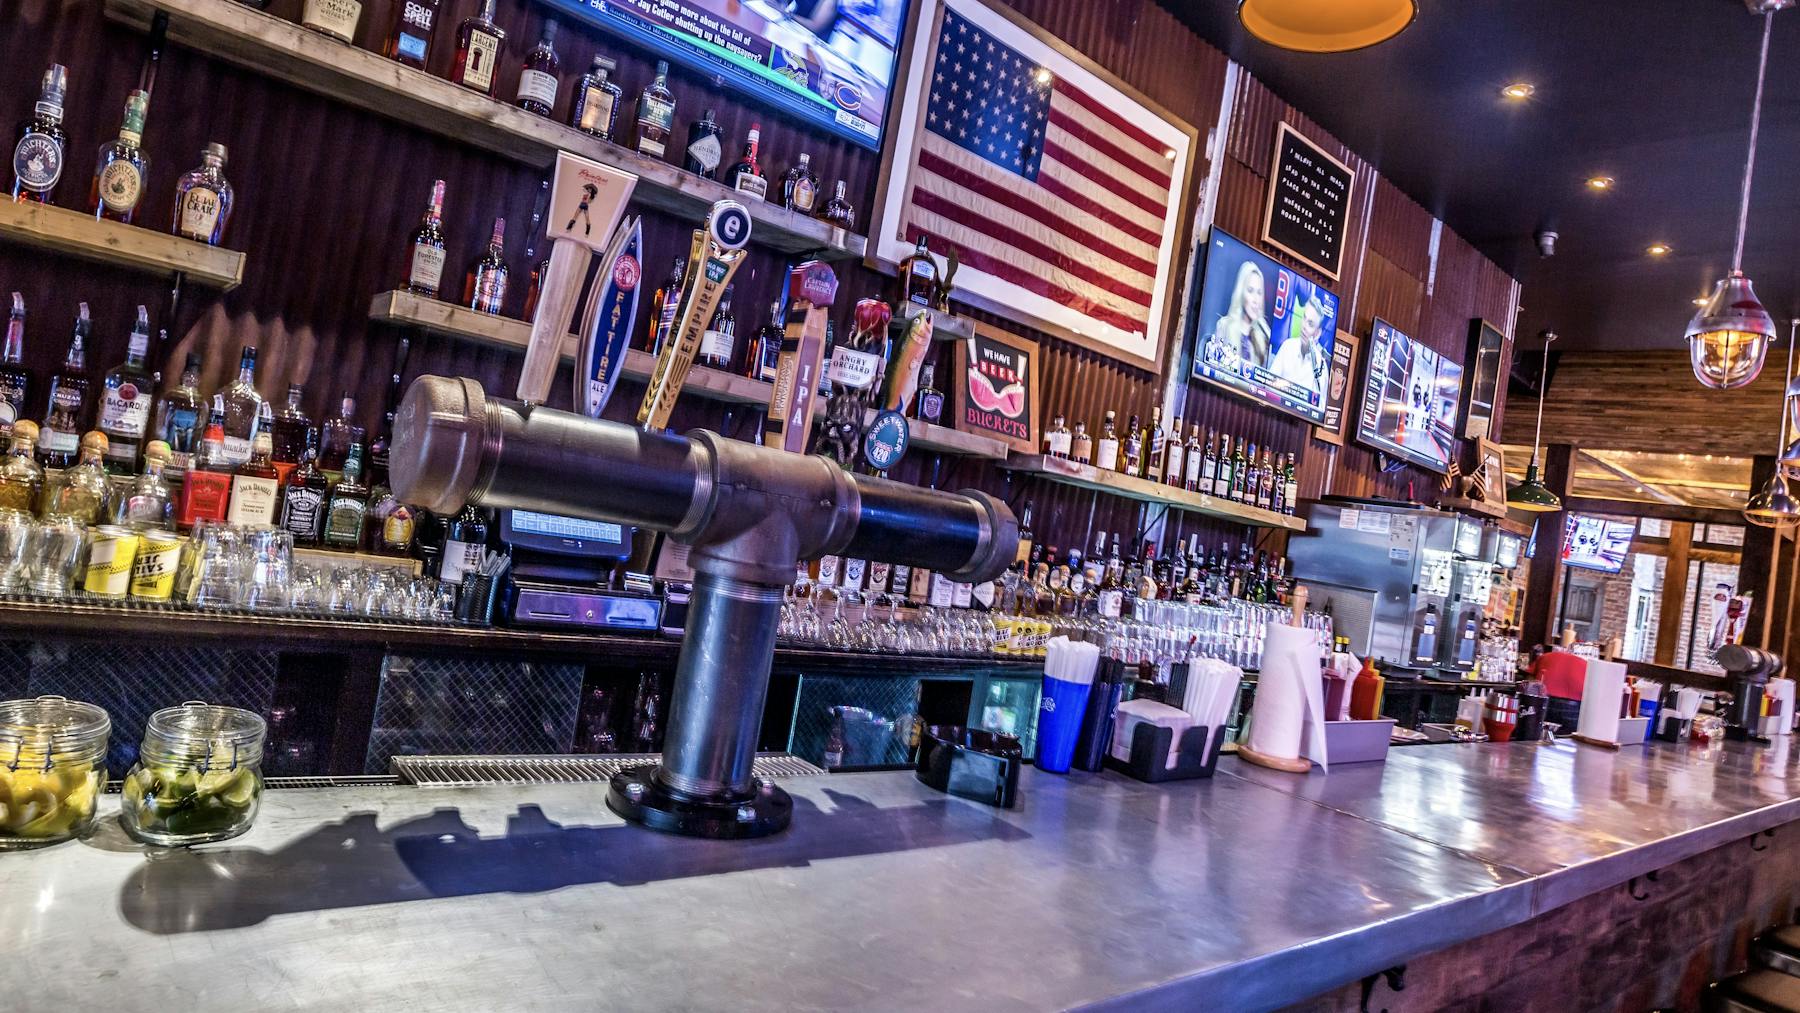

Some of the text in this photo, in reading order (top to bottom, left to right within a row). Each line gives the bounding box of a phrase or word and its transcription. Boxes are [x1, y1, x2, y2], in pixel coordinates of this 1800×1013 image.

[403, 8, 431, 27] SPELL
[405, 1, 433, 18] COLD
[637, 0, 651, 13] Jay
[651, 3, 675, 22] Cutler
[675, 16, 704, 38] shutting
[704, 32, 713, 42] up
[714, 34, 725, 47] the
[726, 40, 763, 64] naysayers?
[659, 0, 752, 46] game more about the fall of
[1285, 164, 1299, 177] LEAD
[1301, 174, 1309, 184] TO
[1282, 177, 1300, 193] PLACE
[1301, 190, 1311, 200] AND
[724, 214, 741, 240] e
[1304, 222, 1320, 236] LEAD
[1324, 234, 1333, 243] TO
[681, 281, 718, 354] EMPIRE
[597, 291, 625, 381] FAT TIRE
[839, 353, 866, 366] ANGRY
[983, 347, 1011, 366] WE HAVE
[833, 360, 870, 375] ORCHARD
[980, 360, 1016, 383] BEER
[52, 391, 81, 402] CRUZAN
[591, 383, 605, 395] ALE
[791, 364, 809, 426] IPA
[106, 396, 144, 410] BACARDI
[967, 407, 1028, 438] BUCKETS
[868, 416, 905, 454] SWEETWATER
[872, 447, 889, 464] 420
[239, 482, 252, 493] JACK
[287, 490, 301, 500] JACK
